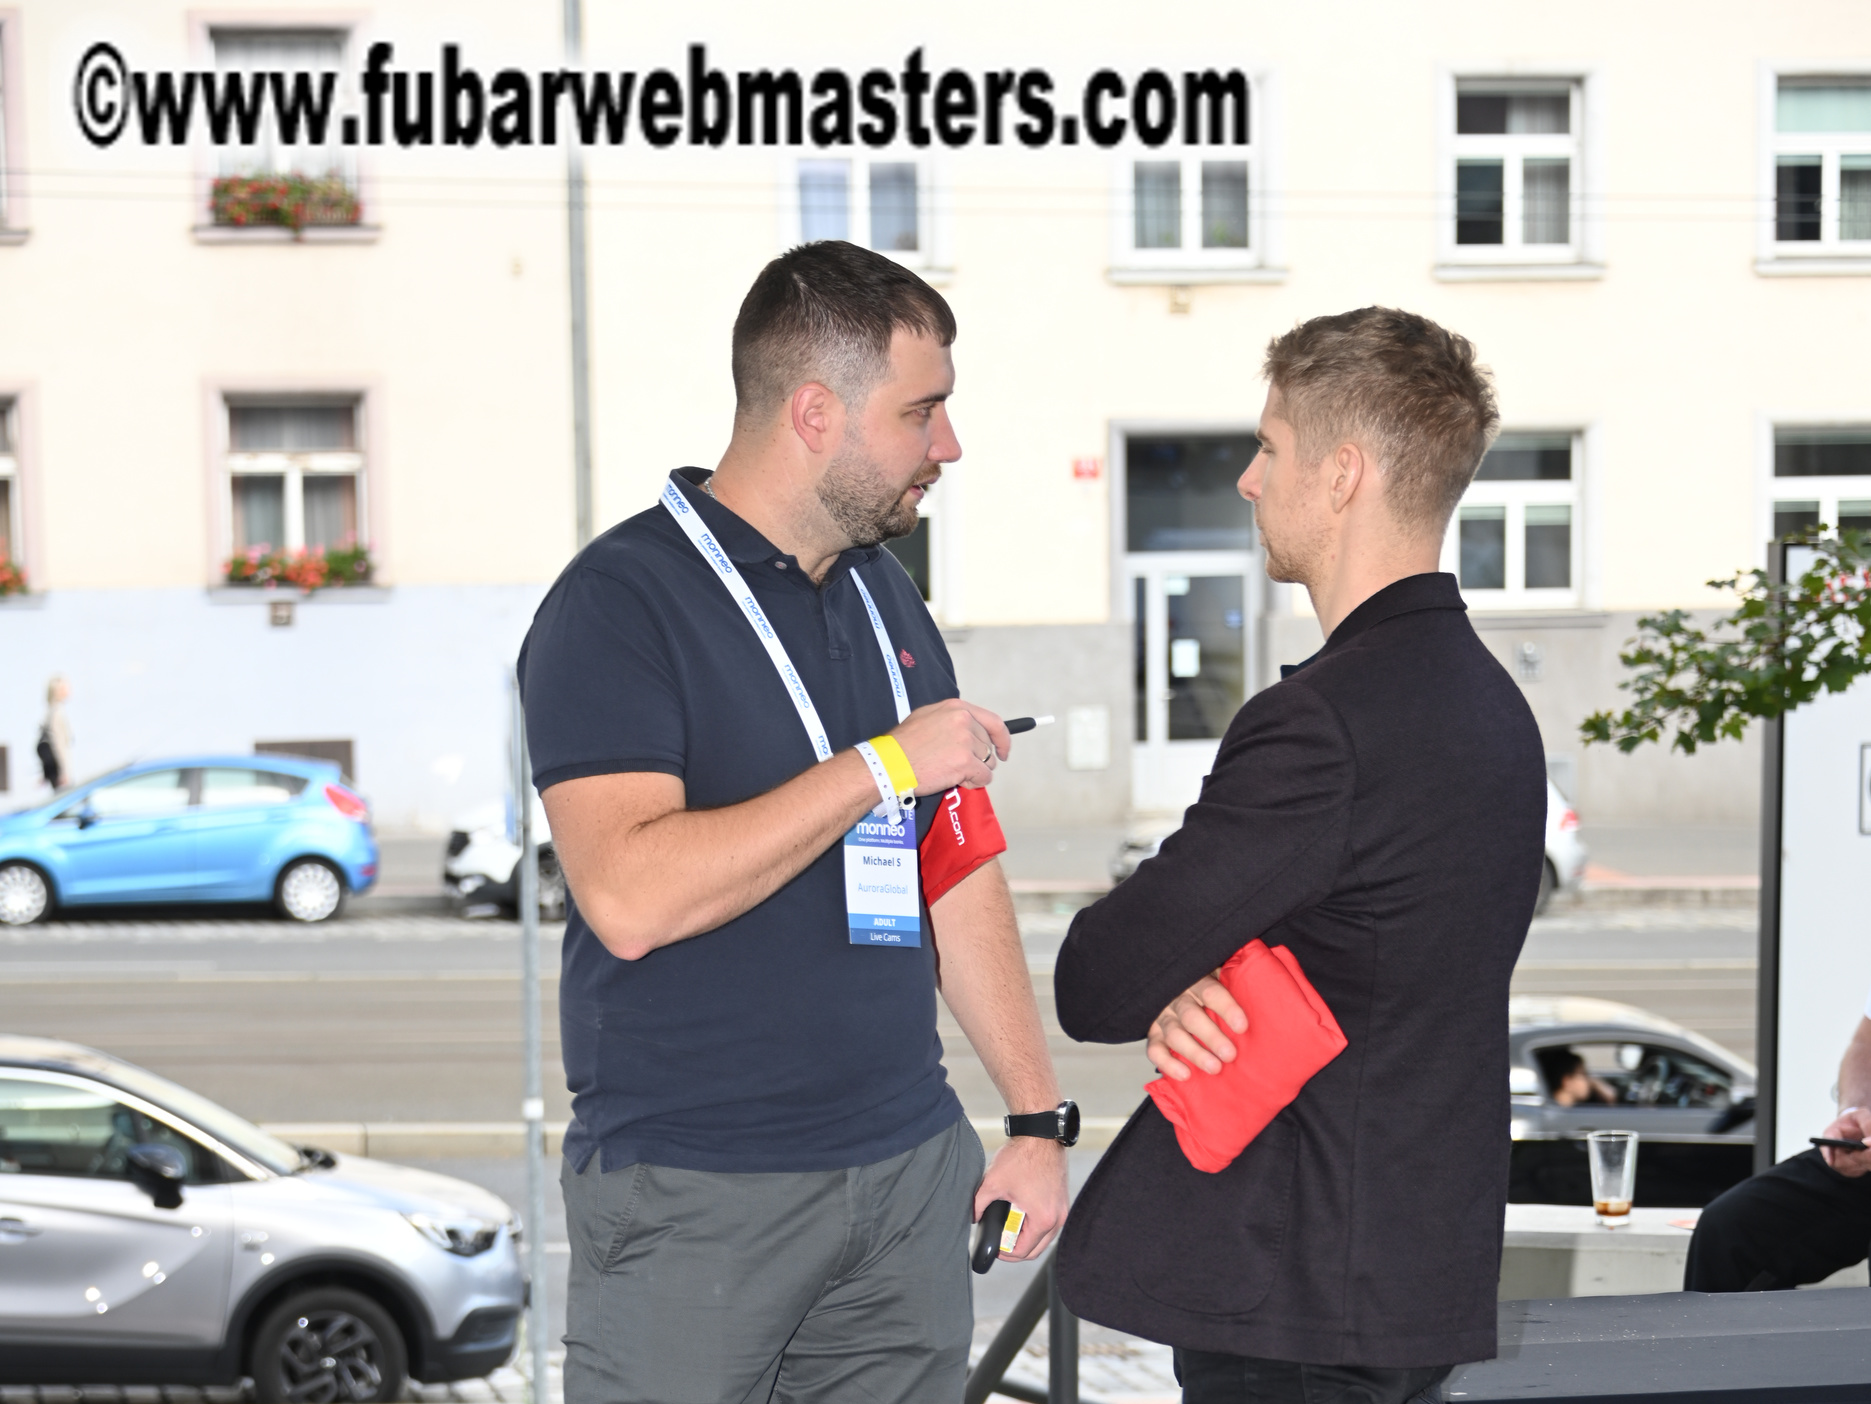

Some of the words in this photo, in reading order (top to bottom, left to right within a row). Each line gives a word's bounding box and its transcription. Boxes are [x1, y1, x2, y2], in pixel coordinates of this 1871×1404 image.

[701, 532, 733, 574] monneo
[745, 596, 774, 639] monneo
[784, 663, 810, 709] monneo
[856, 822, 906, 838] monneo
[863, 855, 895, 867] Michael
[896, 857, 902, 867] S
[857, 882, 909, 895] AuroraGlobal
[873, 917, 897, 927] ADULT
[870, 932, 883, 942] Live
[883, 932, 902, 943] Cams
